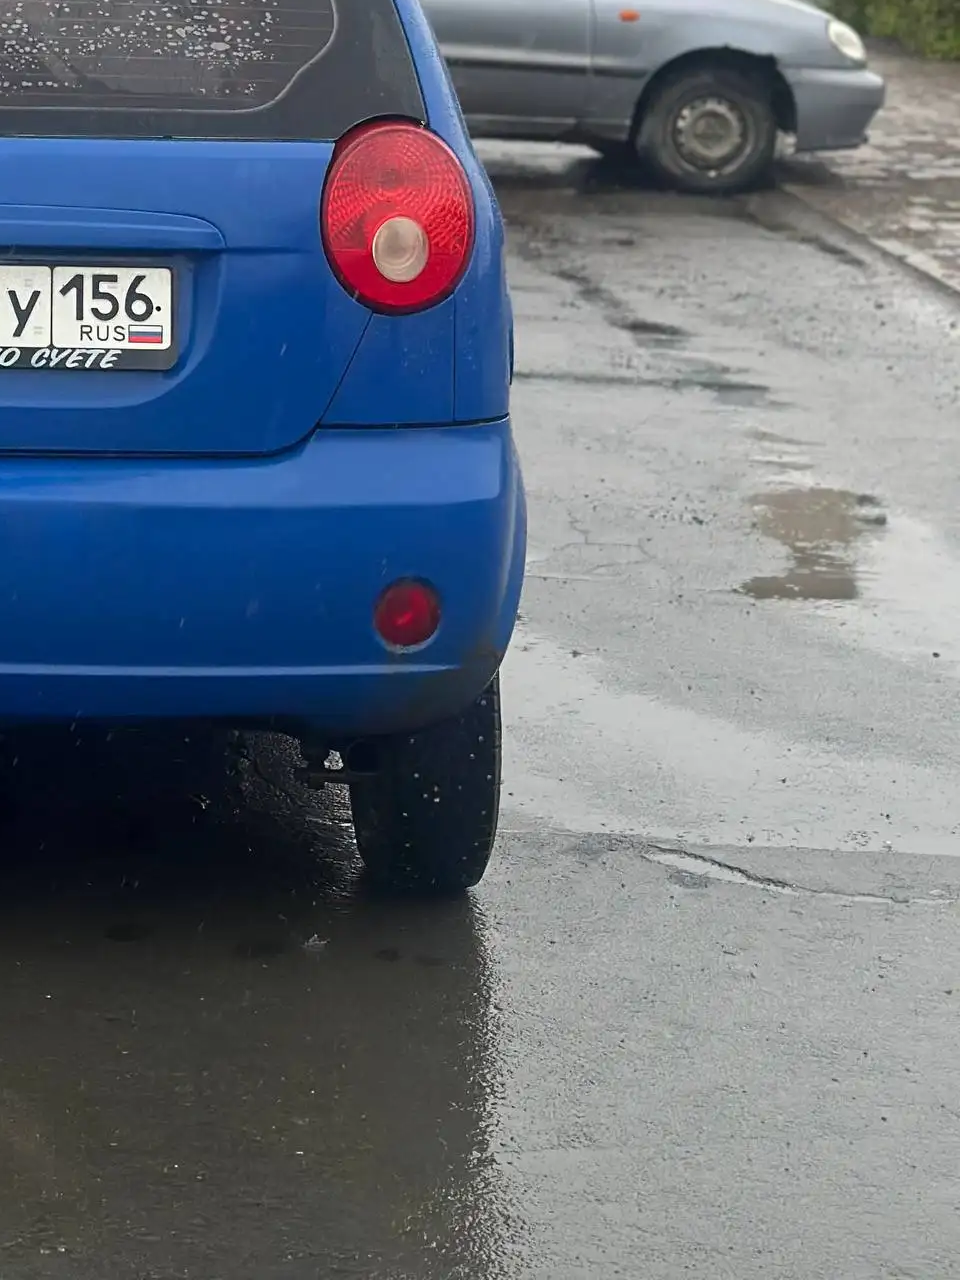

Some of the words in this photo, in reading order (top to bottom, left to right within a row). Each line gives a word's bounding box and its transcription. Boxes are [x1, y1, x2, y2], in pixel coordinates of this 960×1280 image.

[59, 274, 154, 321] 156
[80, 324, 126, 342] RUS
[31, 348, 123, 369] СУЕТЕ
